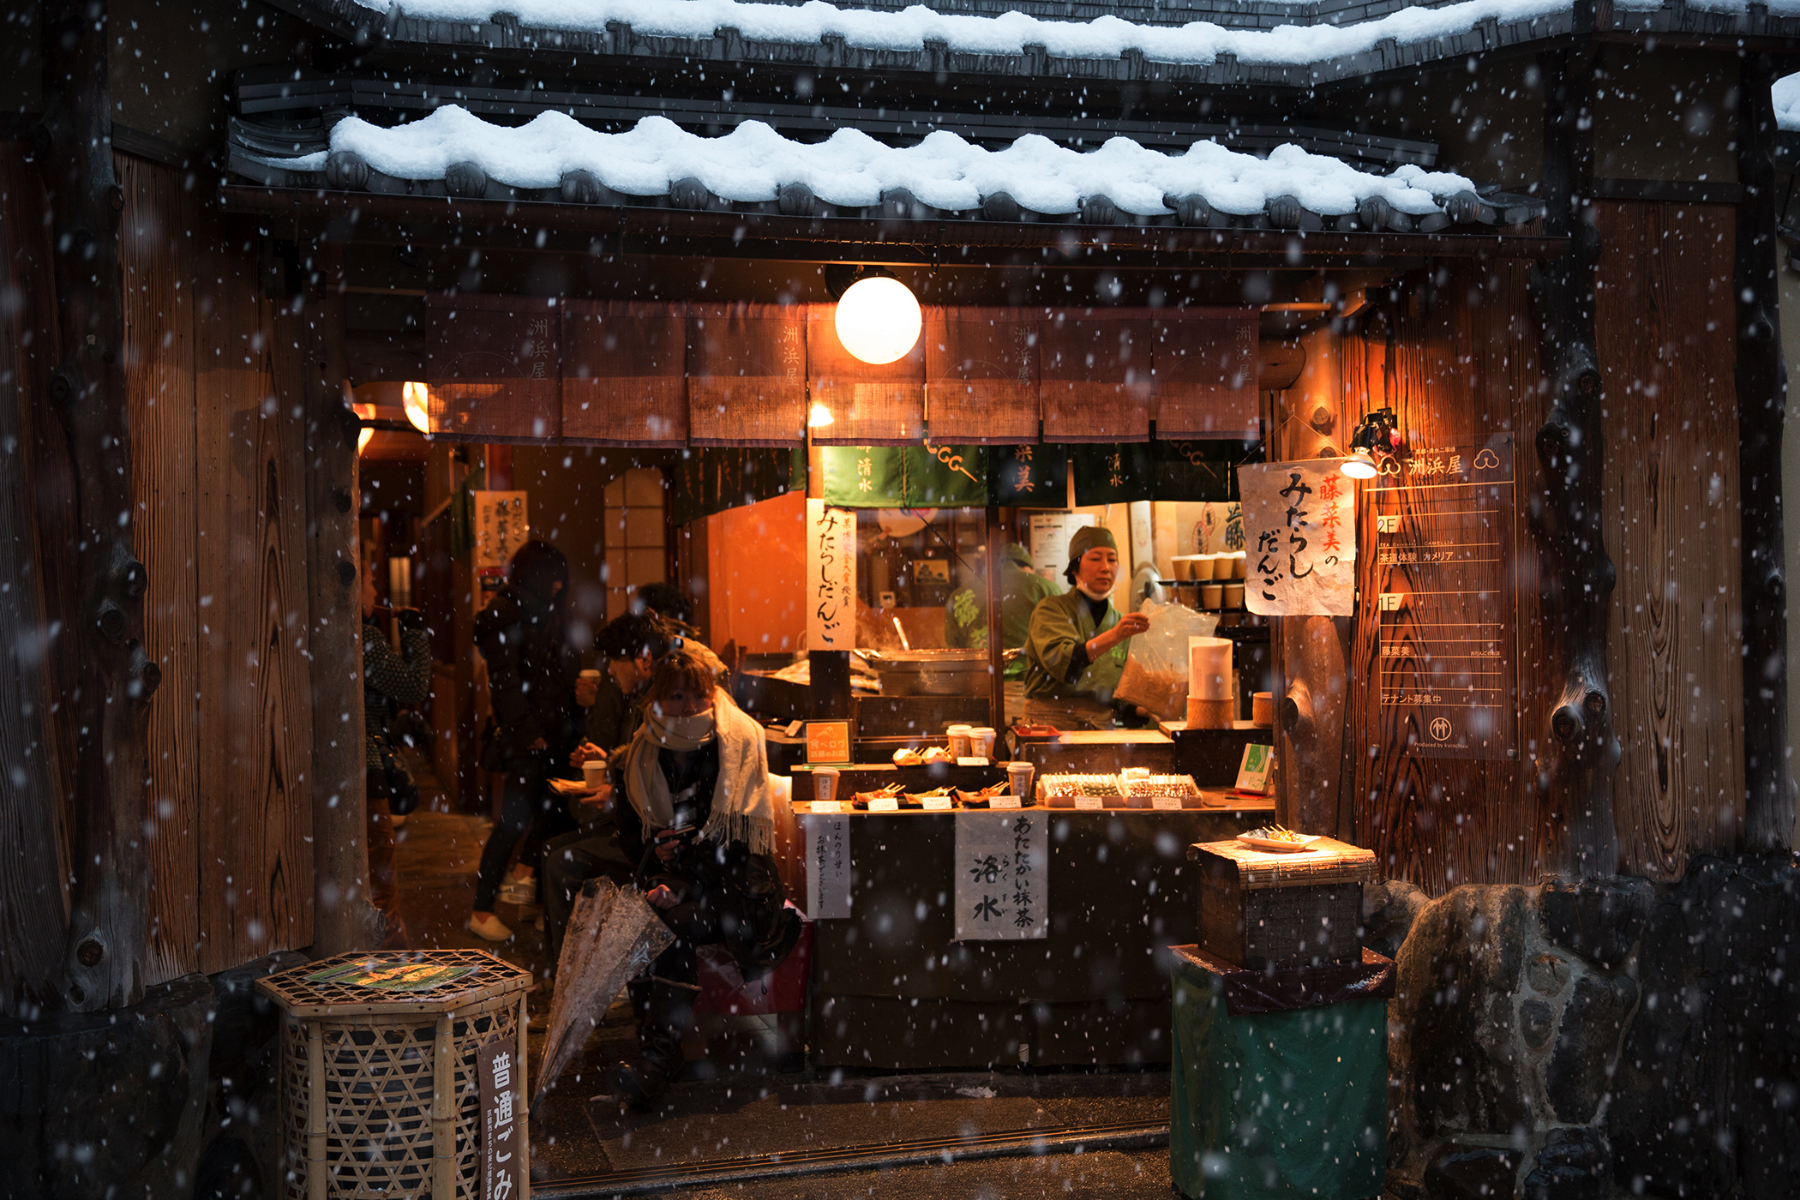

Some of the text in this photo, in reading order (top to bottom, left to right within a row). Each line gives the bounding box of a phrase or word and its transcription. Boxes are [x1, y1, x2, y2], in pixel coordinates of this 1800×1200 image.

[529, 318, 549, 381] 洲浜屋
[783, 325, 800, 387] 洲浜屋
[1014, 326, 1033, 385] 洲浜屋
[1235, 325, 1252, 381] 洲浜屋
[1107, 442, 1124, 487] 清水
[1408, 454, 1464, 476] 洲浜屋
[1279, 473, 1314, 579] みたらし
[1319, 474, 1343, 568] 藤菜美の
[1377, 518, 1396, 533] 2F
[816, 509, 840, 643] みたらしだんご
[1257, 528, 1284, 601] だんご
[1380, 551, 1454, 562] 茶道体験 カメリア
[1380, 596, 1396, 611] 1F
[1382, 694, 1442, 704] テナント募集中
[810, 738, 846, 750] 食べログ
[833, 821, 843, 878] ほんのり甘い
[1012, 815, 1035, 928] あたたかい抹茶
[492, 1051, 514, 1200] 普通ごみ
